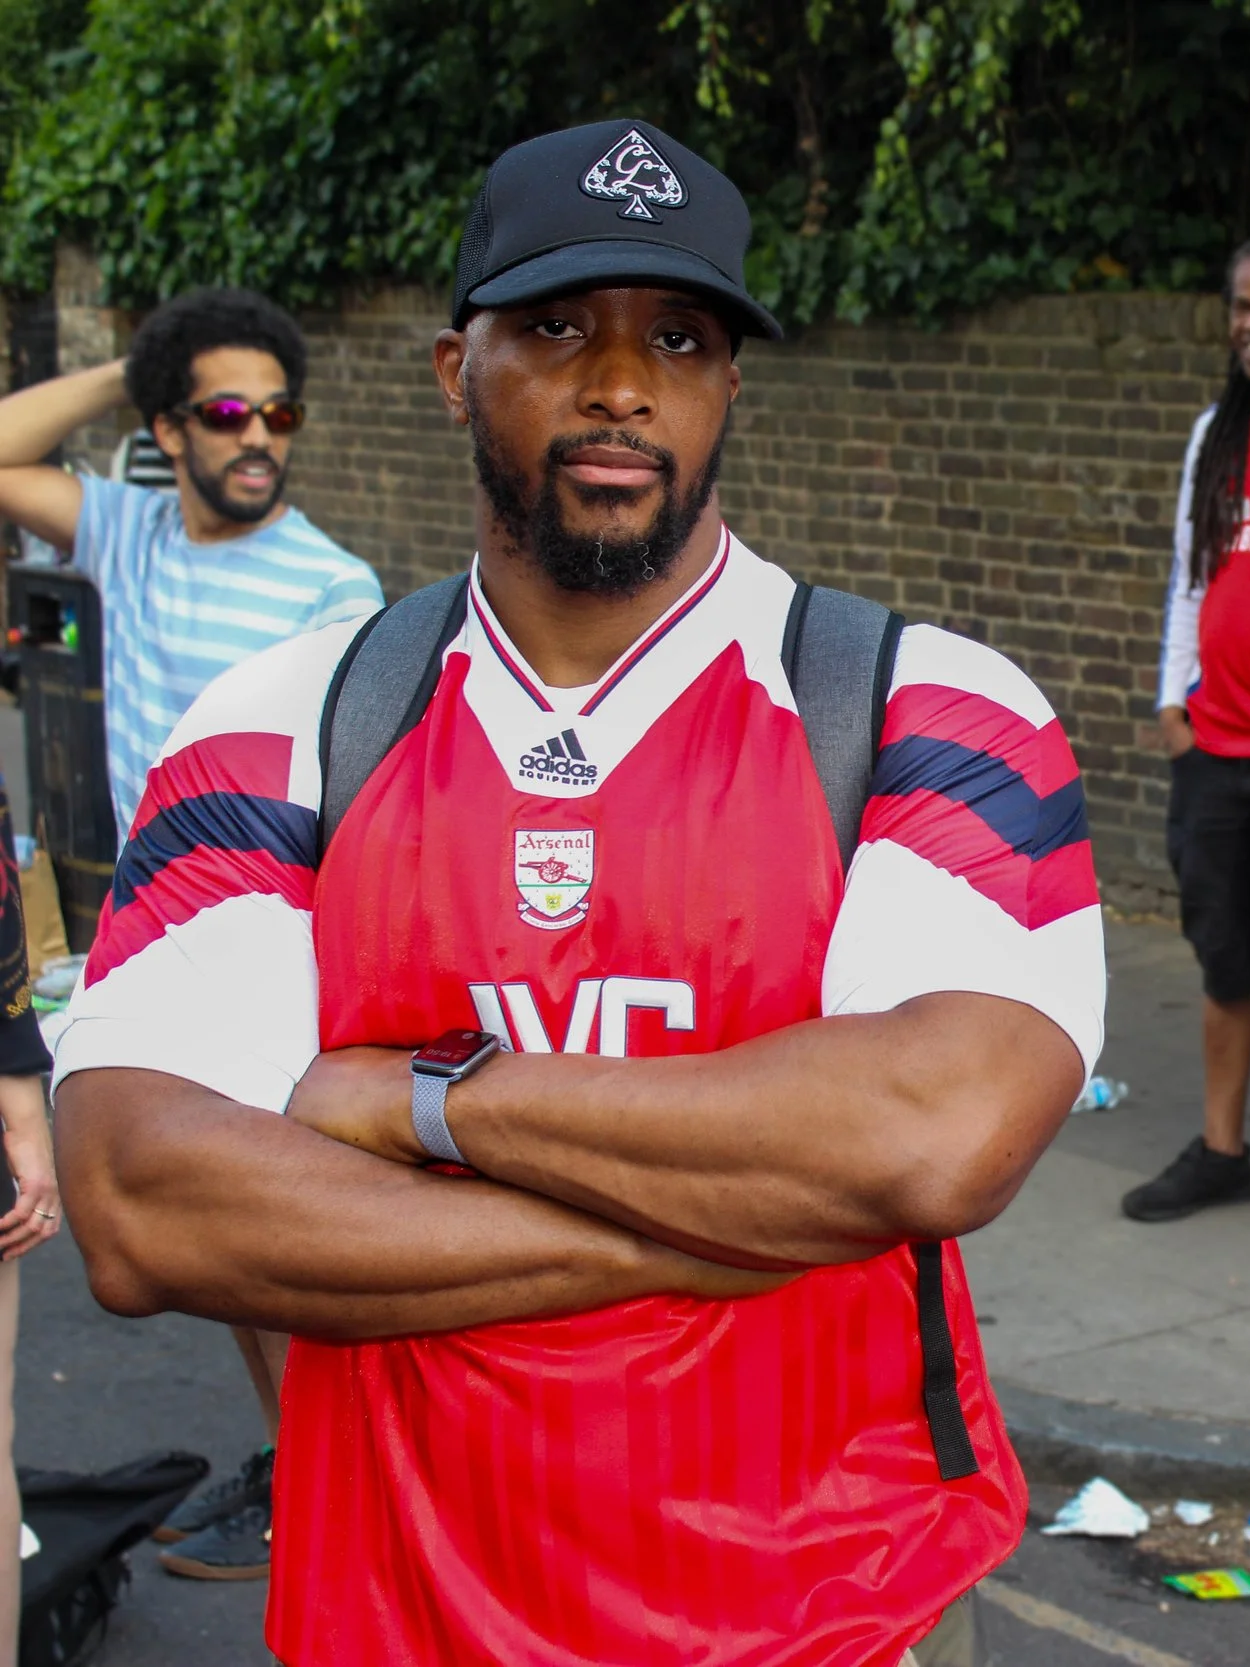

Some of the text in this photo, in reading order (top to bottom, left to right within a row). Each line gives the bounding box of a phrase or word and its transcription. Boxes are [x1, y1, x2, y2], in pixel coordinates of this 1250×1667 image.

[519, 753, 599, 778] adidas
[518, 768, 597, 786] EQUIPMENT
[518, 832, 591, 850] Arsenal
